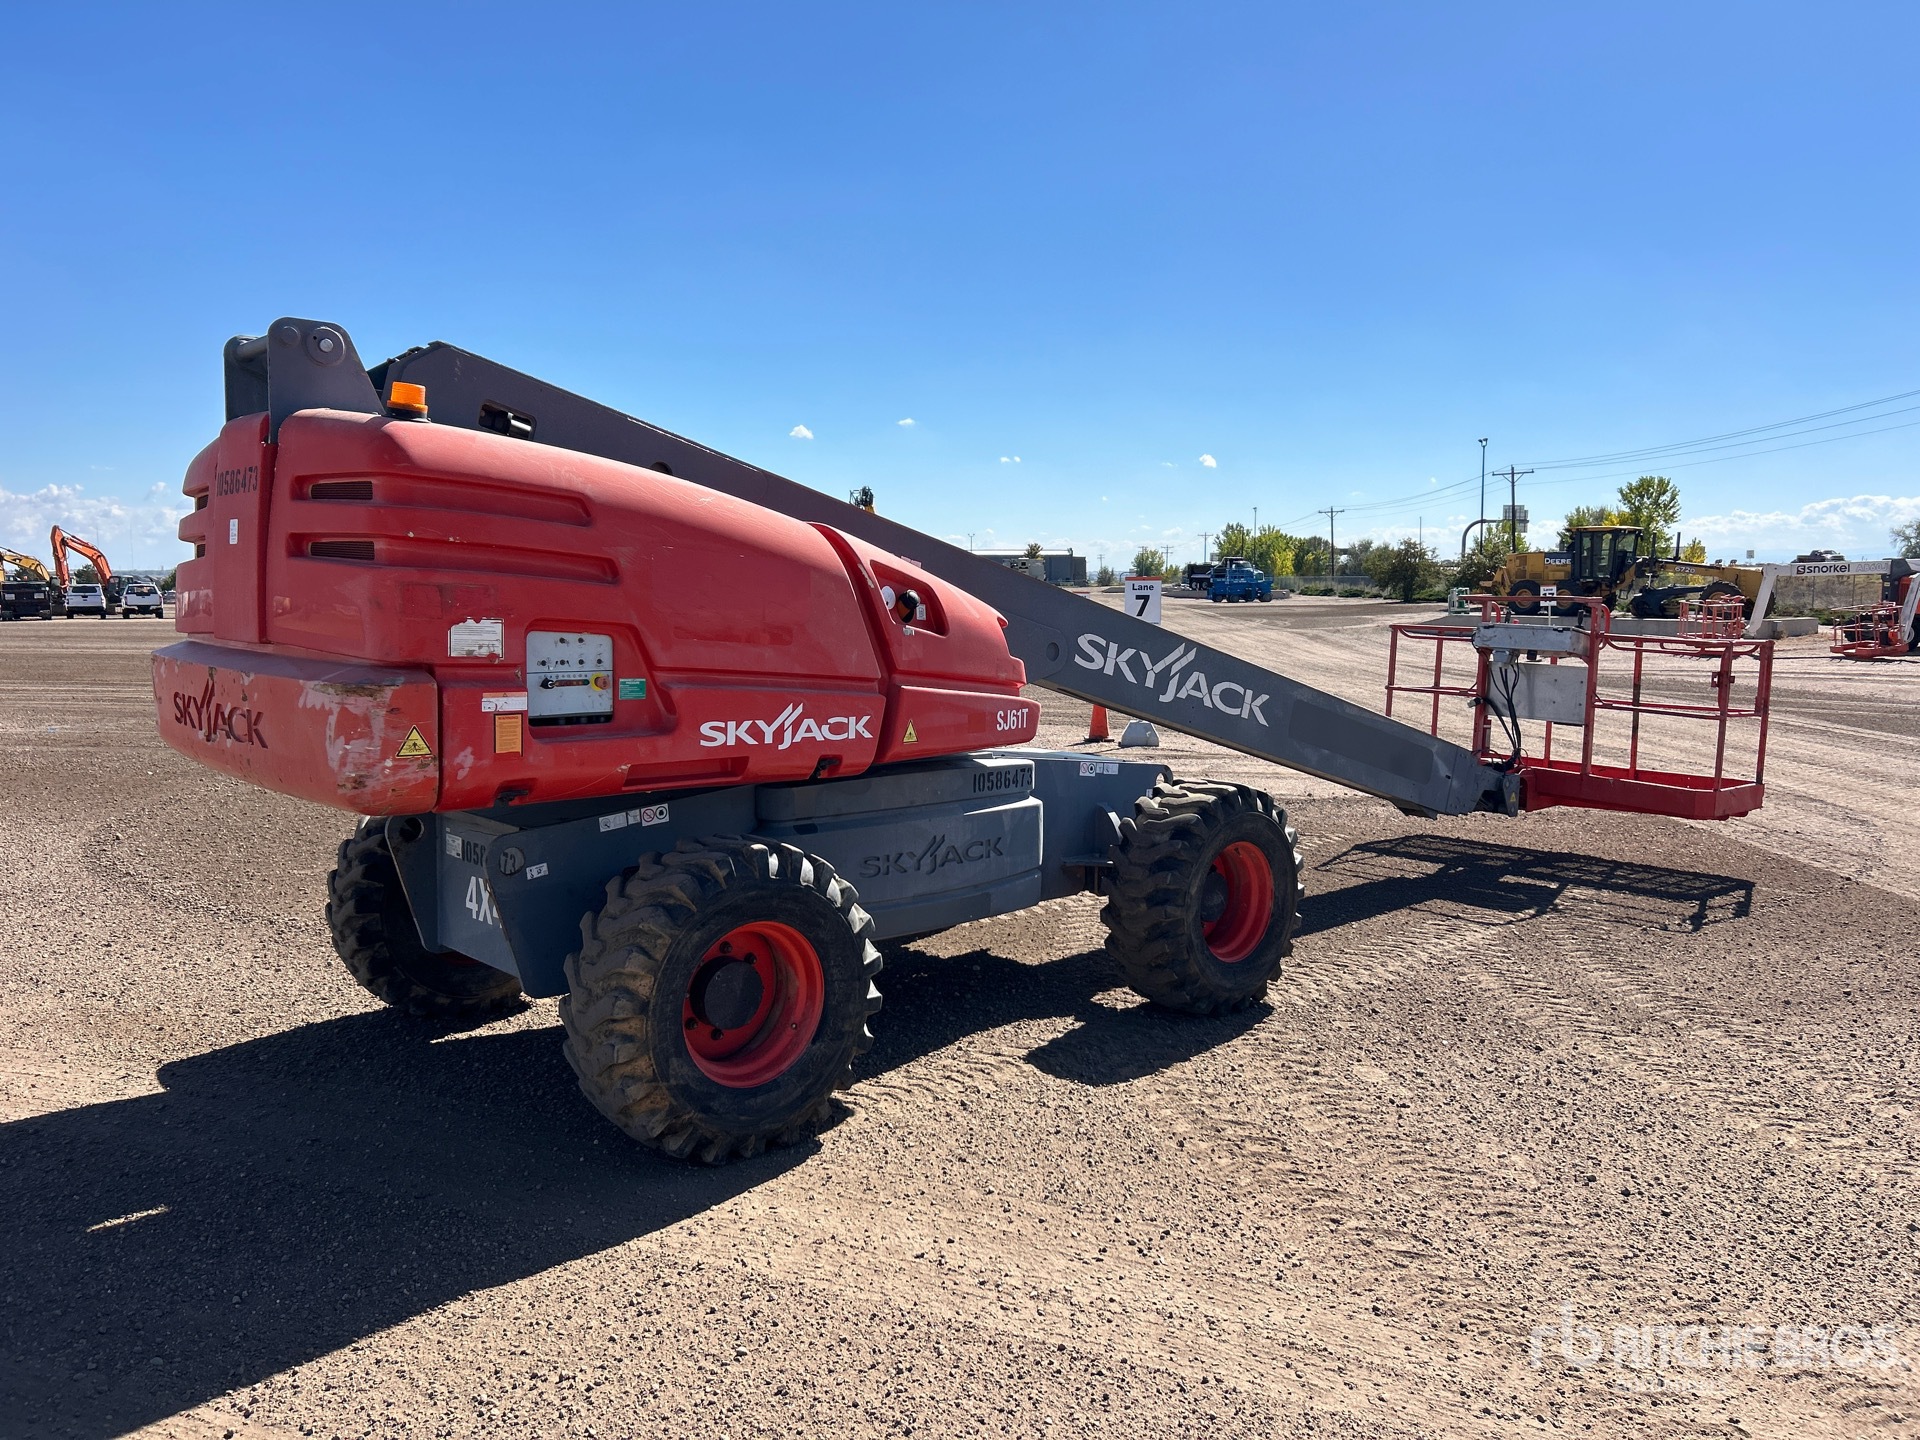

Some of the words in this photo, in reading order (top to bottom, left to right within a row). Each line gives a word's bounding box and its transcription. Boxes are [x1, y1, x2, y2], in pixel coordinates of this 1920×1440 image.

[216, 465, 258, 497] 10586473
[1544, 557, 1572, 565] DEERE
[1806, 563, 1851, 574] snorkel
[1856, 563, 1888, 572] AB60J
[1132, 583, 1154, 591] Lane
[1135, 594, 1150, 617] 7
[1073, 633, 1270, 727] SKYJACK
[173, 678, 269, 749] SKYJACK
[699, 702, 874, 750] SKYJACK
[996, 708, 1029, 731] SJ61T
[973, 767, 1033, 793] 10586473
[859, 834, 1004, 878] SKYJACK
